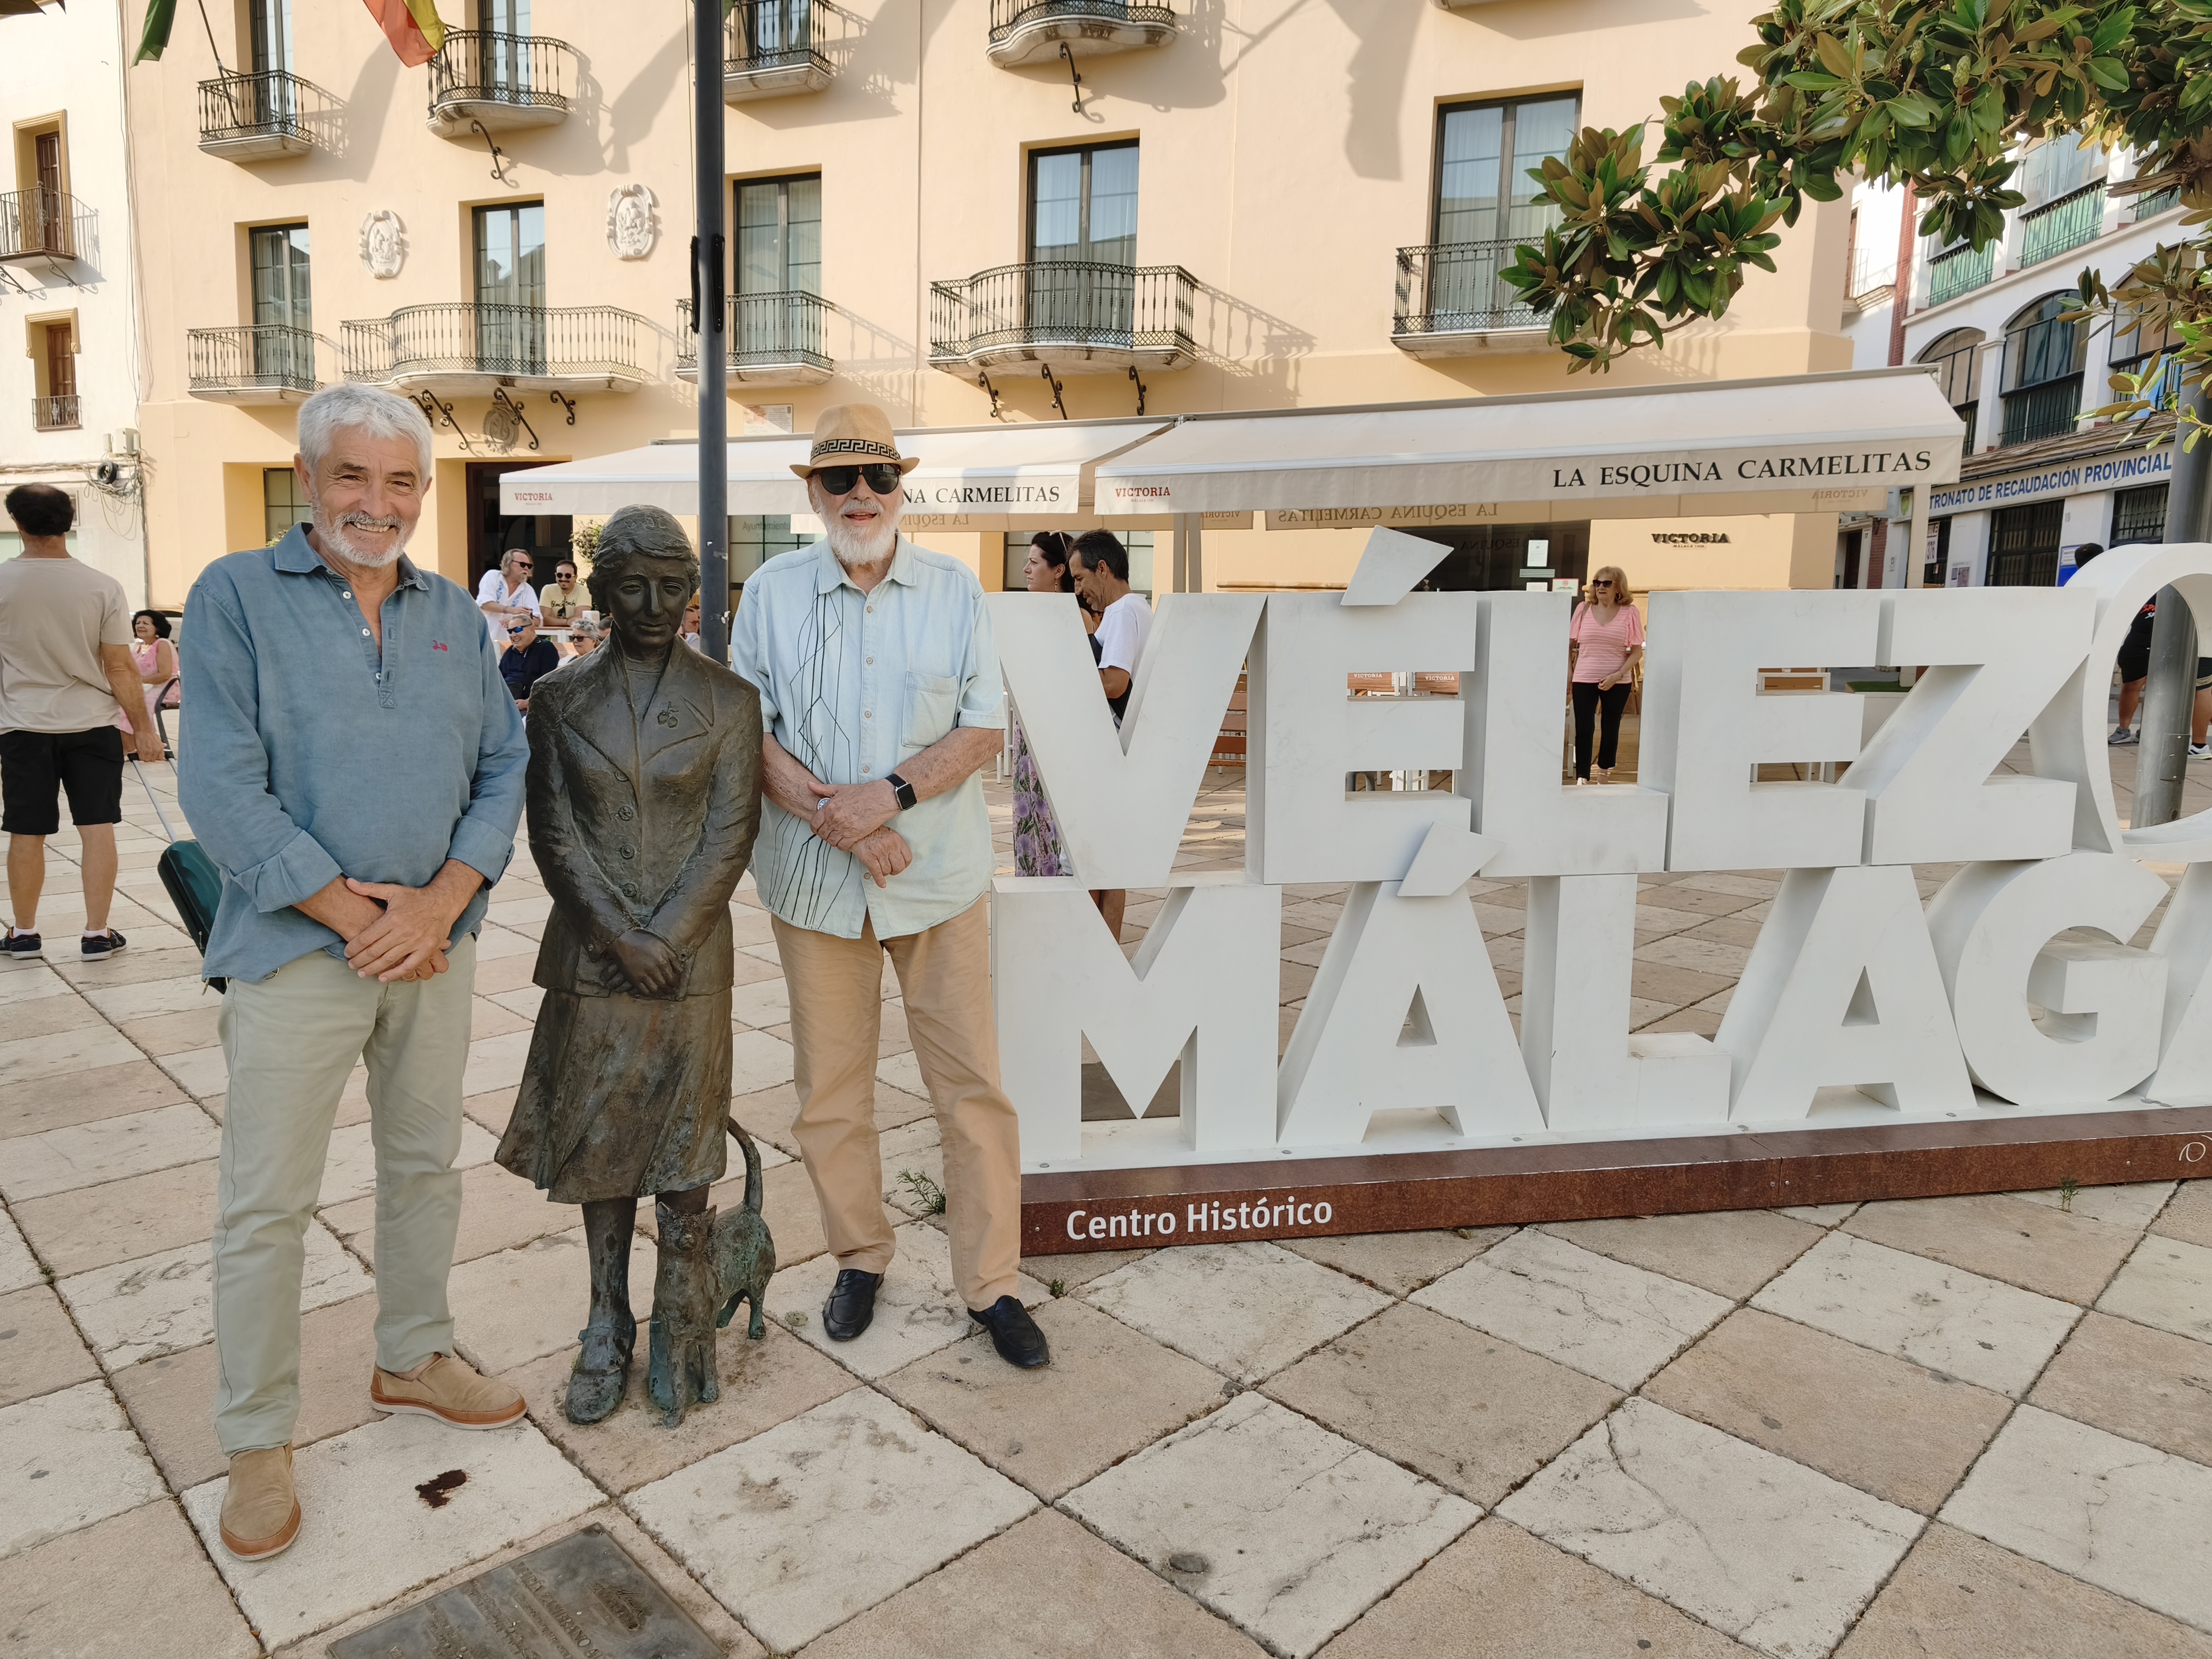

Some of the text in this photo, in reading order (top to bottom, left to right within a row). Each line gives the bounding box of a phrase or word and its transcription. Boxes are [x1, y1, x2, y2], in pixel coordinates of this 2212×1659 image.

[1553, 451, 1931, 488] LA ESQUINA CARMELITAS
[1978, 484, 1992, 501] DE
[1995, 466, 2080, 499] RECAUDACIÓN
[2085, 452, 2172, 484] PROVINCIAL
[514, 493, 553, 501] VICTORIA
[935, 486, 1060, 503] CARMELITAS
[1115, 487, 1171, 497] VICTORIA
[1651, 533, 1729, 543] VICTORIA
[985, 524, 2098, 889] VÉLEZ
[993, 822, 2212, 1162] MÁLAG
[1067, 1195, 1333, 1240] Centro Histórico
